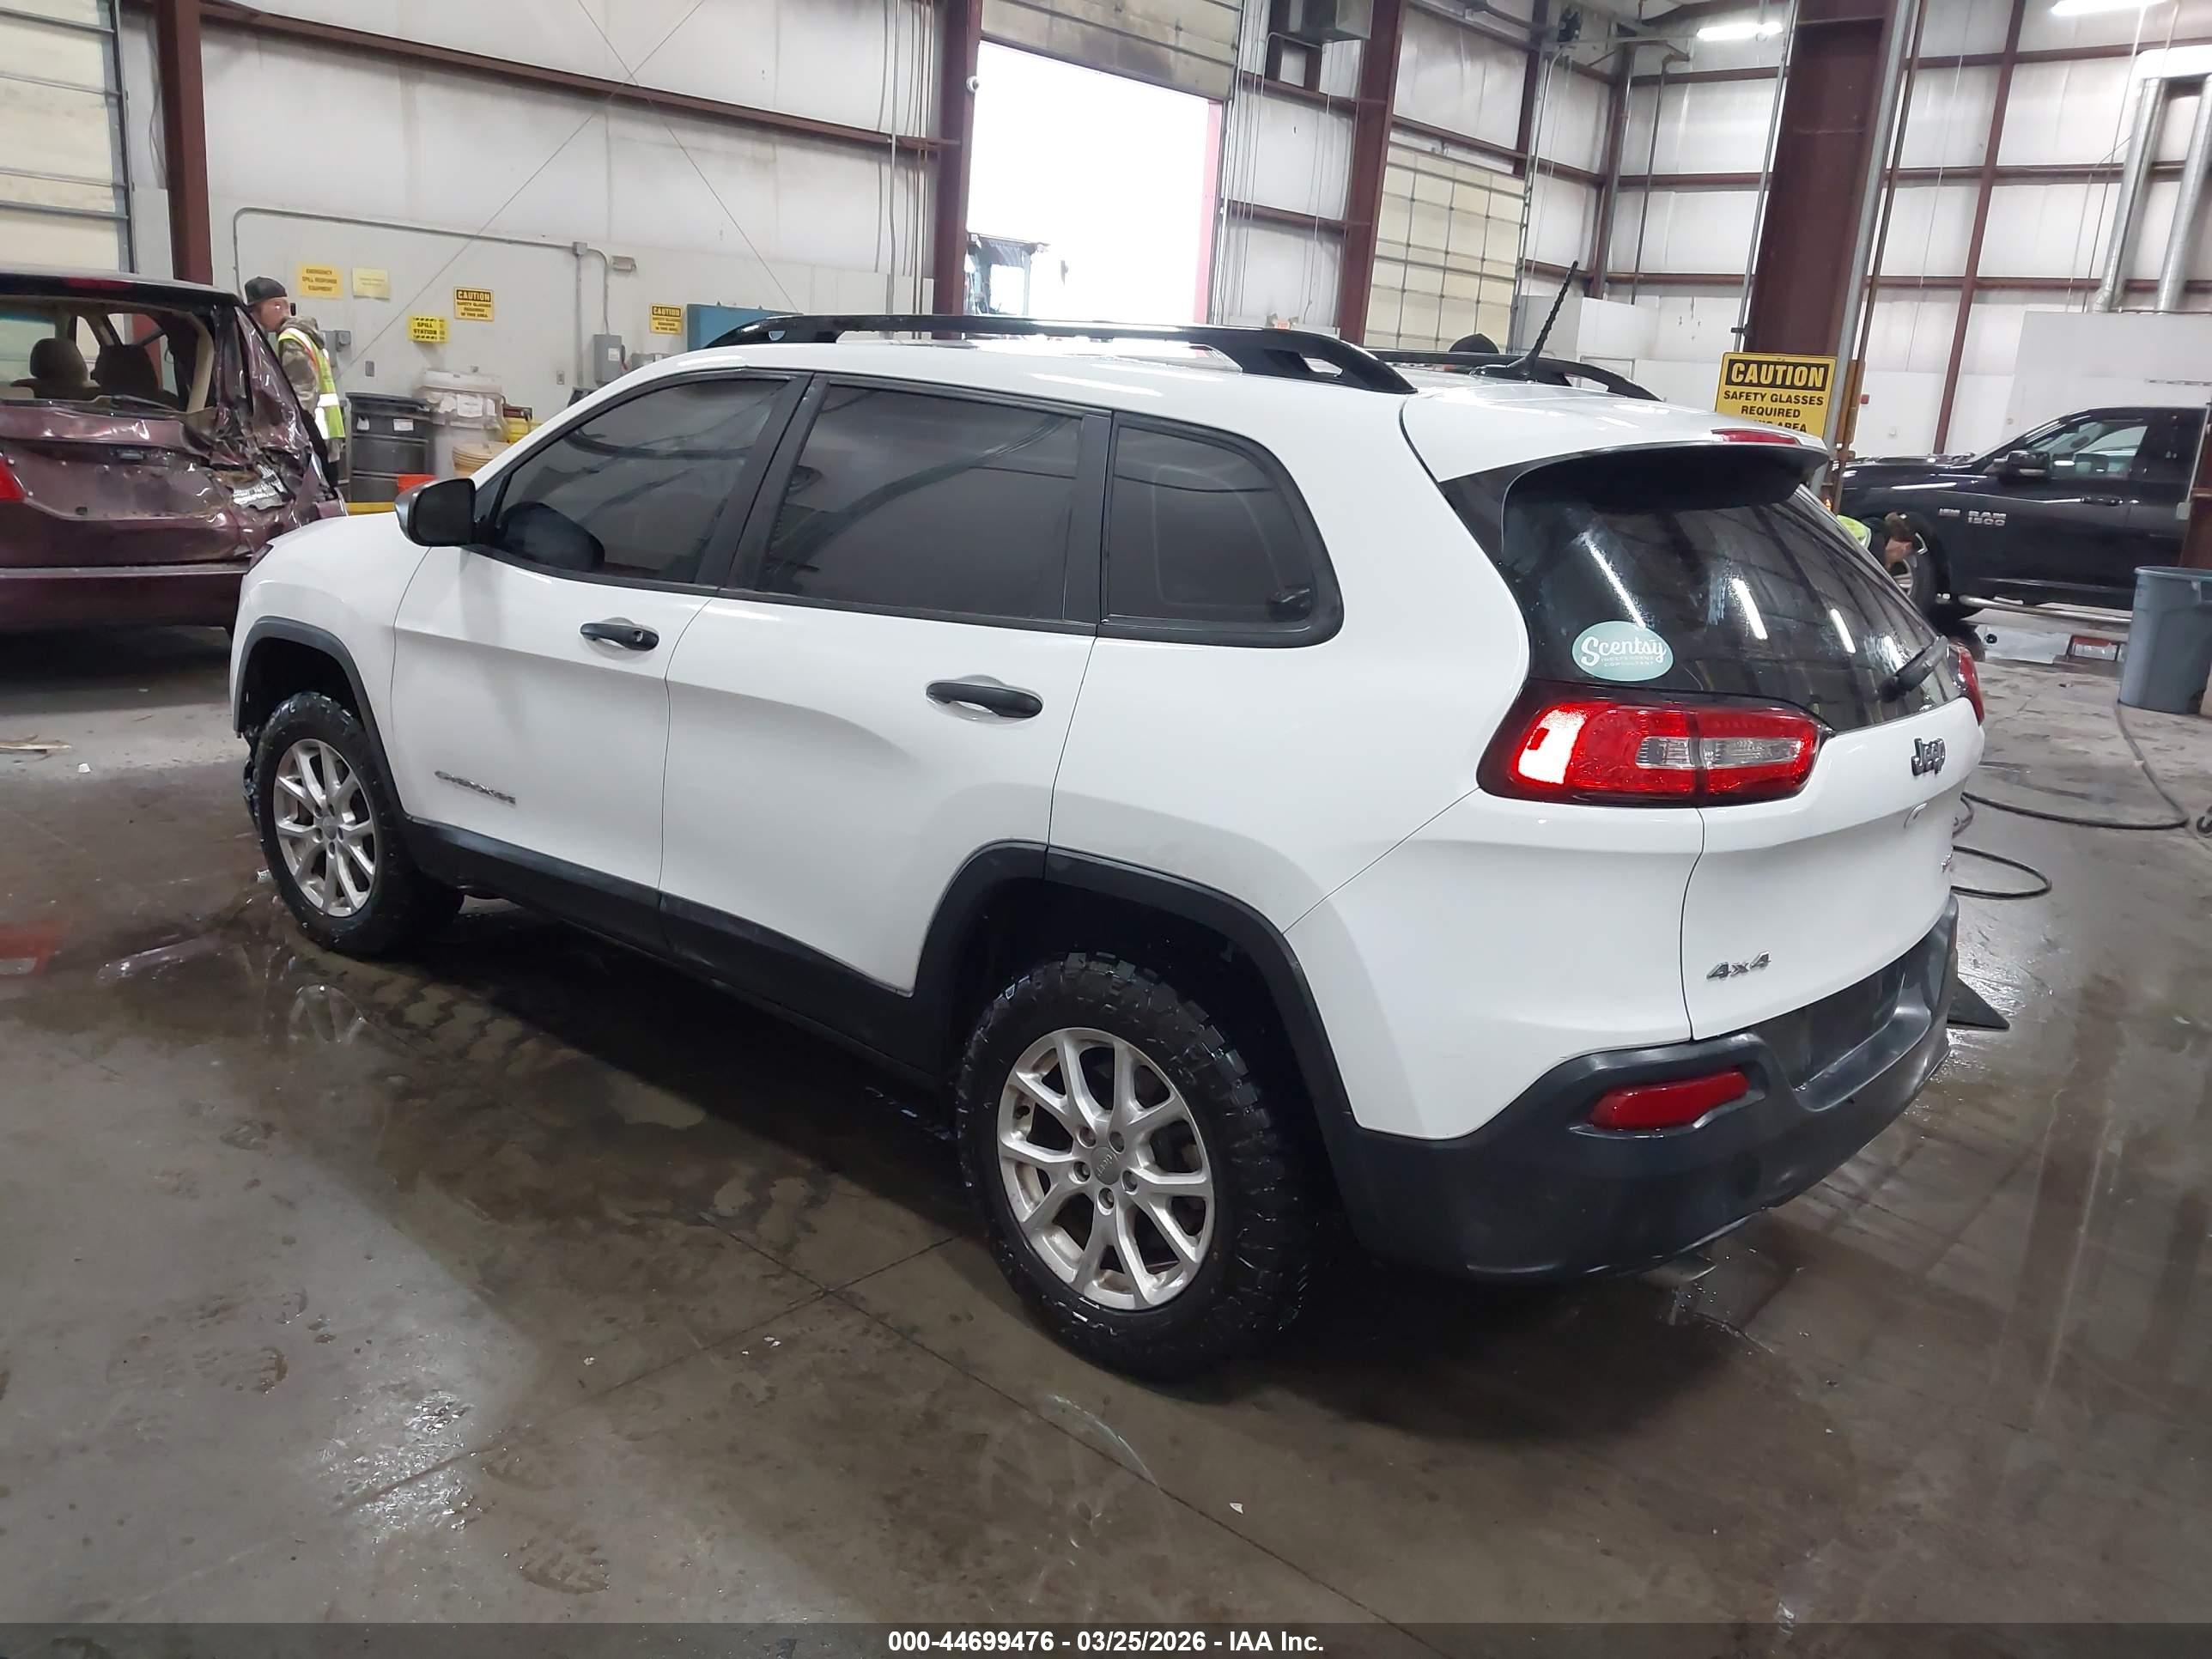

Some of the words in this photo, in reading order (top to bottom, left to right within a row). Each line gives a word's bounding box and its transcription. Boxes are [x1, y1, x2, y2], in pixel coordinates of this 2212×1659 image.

[458, 291, 490, 302] CAUTION
[653, 307, 680, 316] CAUTION
[1731, 362, 1825, 387] CAUTION
[1723, 390, 1767, 402] SAFETY
[1770, 393, 1825, 406] GLASSES
[1741, 405, 1802, 419] REQUIRED
[1967, 517, 2006, 526] 1500
[1581, 636, 1667, 666] Scentsy
